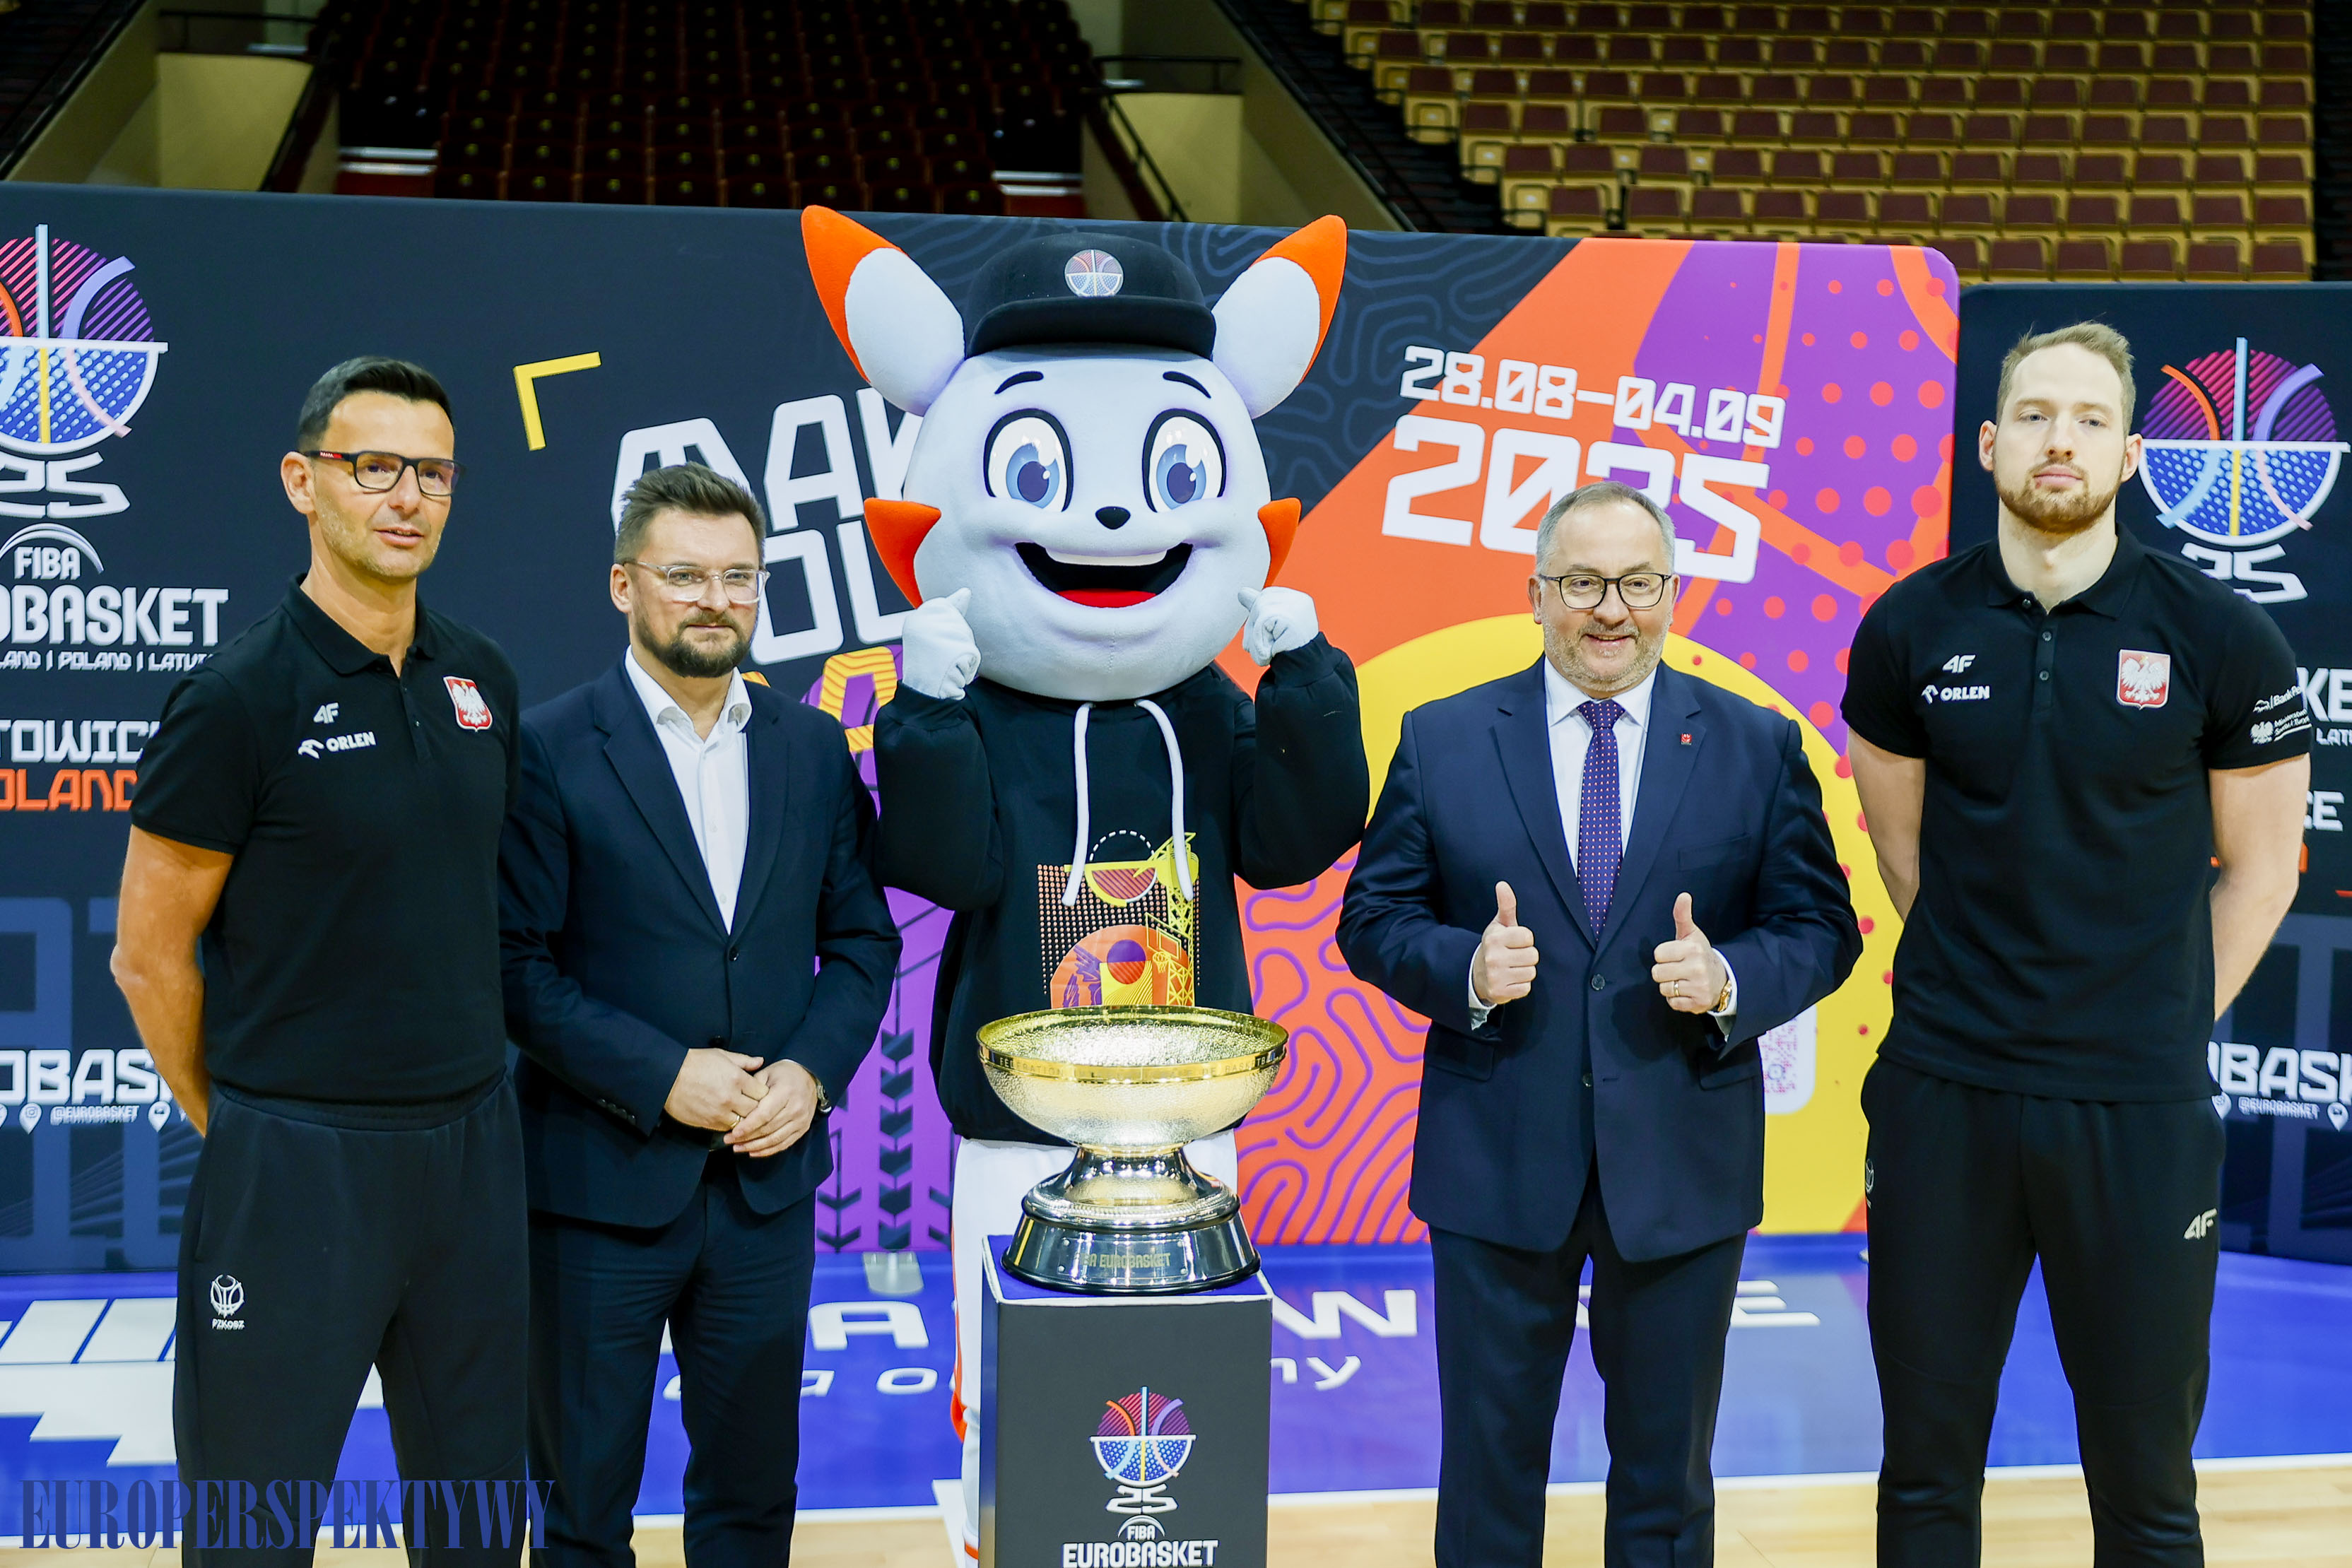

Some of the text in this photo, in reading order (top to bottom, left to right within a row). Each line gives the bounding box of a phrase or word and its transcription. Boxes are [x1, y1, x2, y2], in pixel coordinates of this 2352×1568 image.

[14, 546, 81, 581] FIBA
[57, 651, 132, 671] POLAND
[1941, 654, 1976, 673] 4F
[1940, 685, 1991, 702] ORLEN
[313, 702, 340, 725] 4F
[326, 731, 377, 753] ORLEN
[50, 1105, 140, 1126] @EUROBASKET
[2183, 1208, 2218, 1239] 4F
[1099, 1252, 1171, 1268] EUROBASKET
[1127, 1524, 1157, 1541] FIBA
[1062, 1539, 1220, 1568] EUROBASKET
